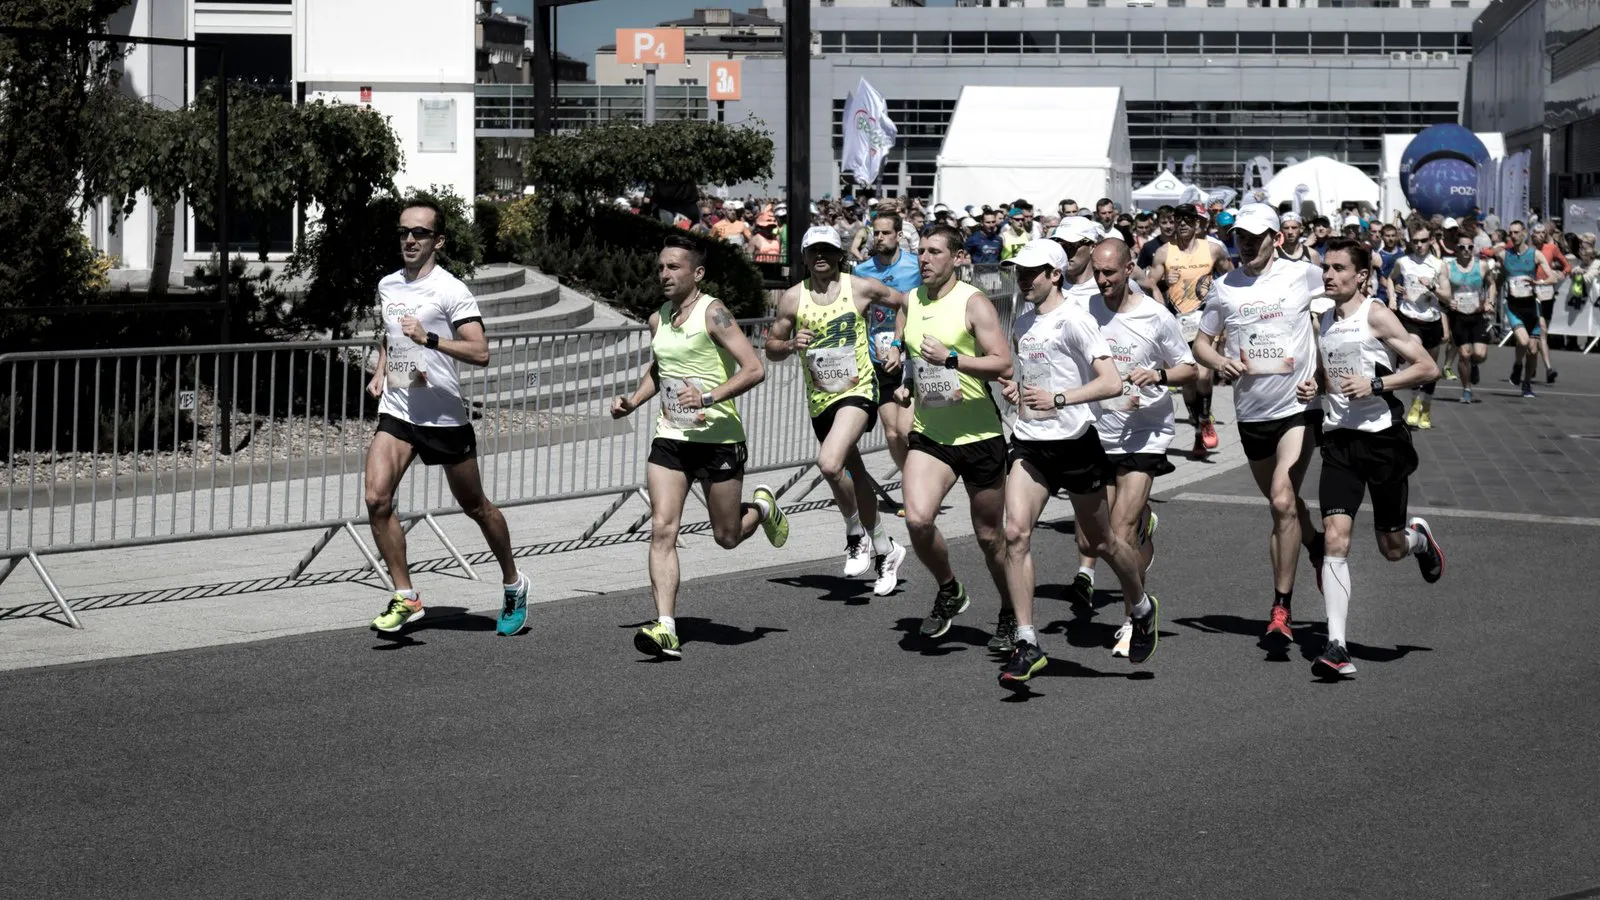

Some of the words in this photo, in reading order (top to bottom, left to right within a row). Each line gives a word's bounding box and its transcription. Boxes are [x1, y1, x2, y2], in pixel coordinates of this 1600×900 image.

[716, 67, 735, 93] 3A
[388, 306, 417, 316] Benecol
[1243, 300, 1282, 317] Benecol
[1260, 311, 1284, 320] team
[1112, 353, 1132, 363] eam
[1248, 347, 1285, 359] 84832
[388, 361, 417, 372] 84875
[817, 368, 850, 381] 85064
[919, 380, 952, 394] 30858
